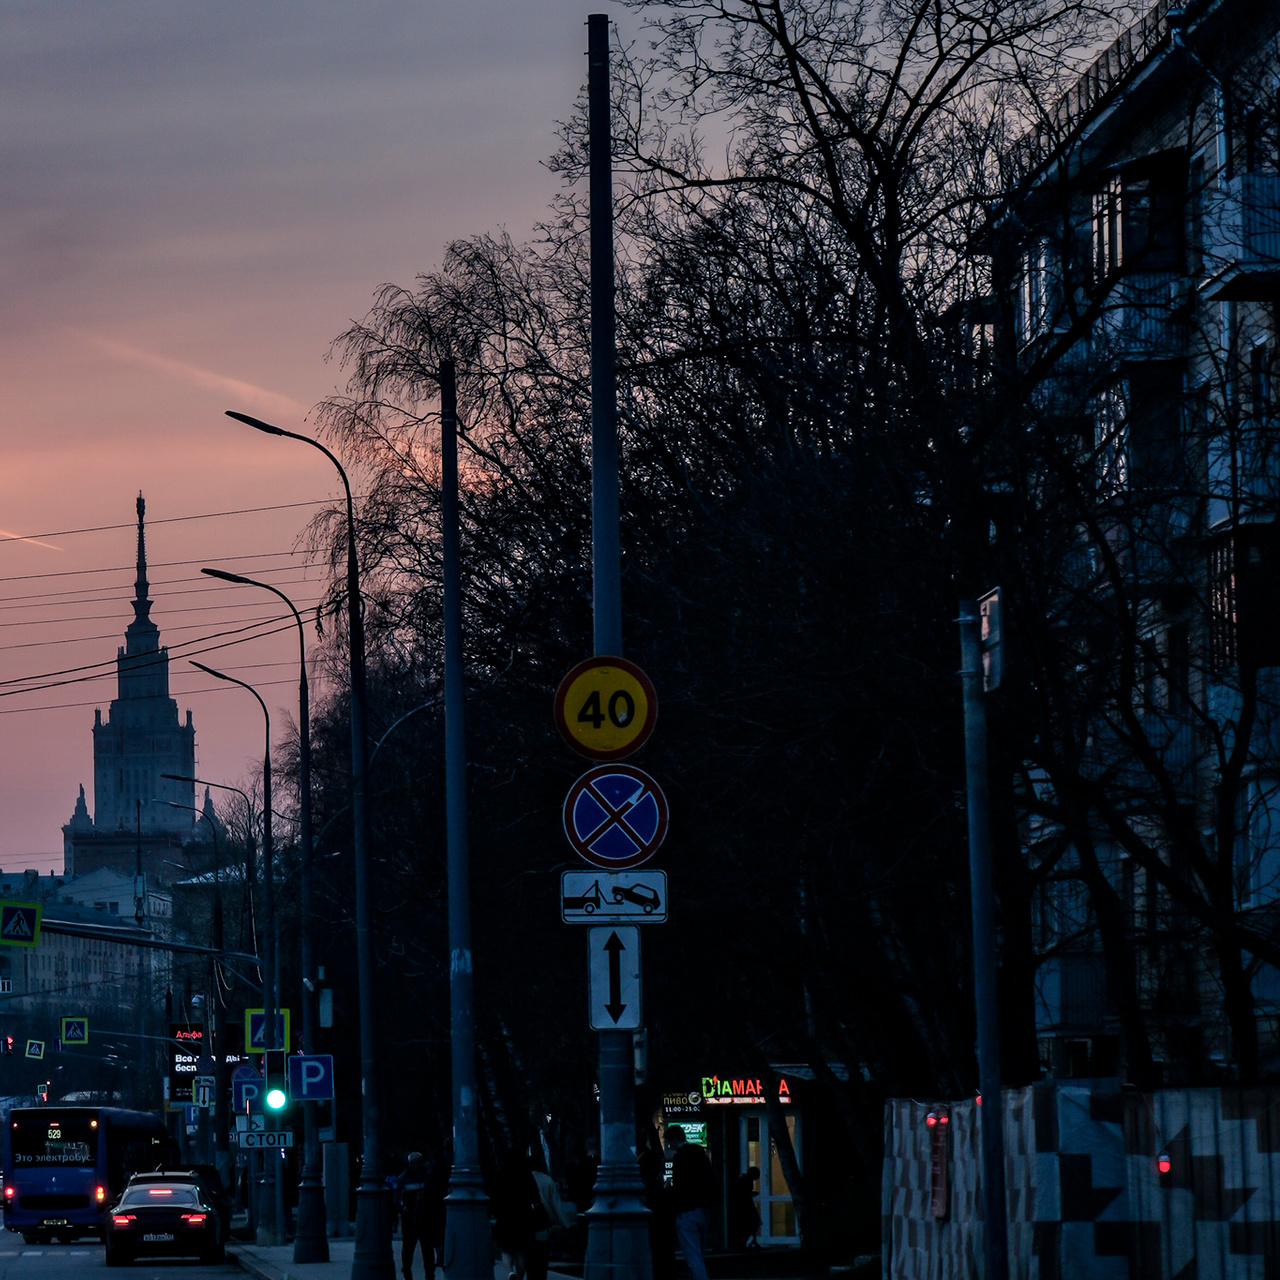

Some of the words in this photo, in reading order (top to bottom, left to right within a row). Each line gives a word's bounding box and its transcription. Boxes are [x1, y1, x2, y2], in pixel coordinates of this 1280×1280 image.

[578, 690, 635, 728] 40
[175, 1054, 193, 1063] Все
[701, 1075, 790, 1097] DIAMAA
[663, 1097, 688, 1105] ПИВО
[48, 1129, 61, 1139] 529
[246, 1133, 287, 1146] СТОП
[15, 1153, 33, 1162] Это
[35, 1152, 95, 1163] электробус.
